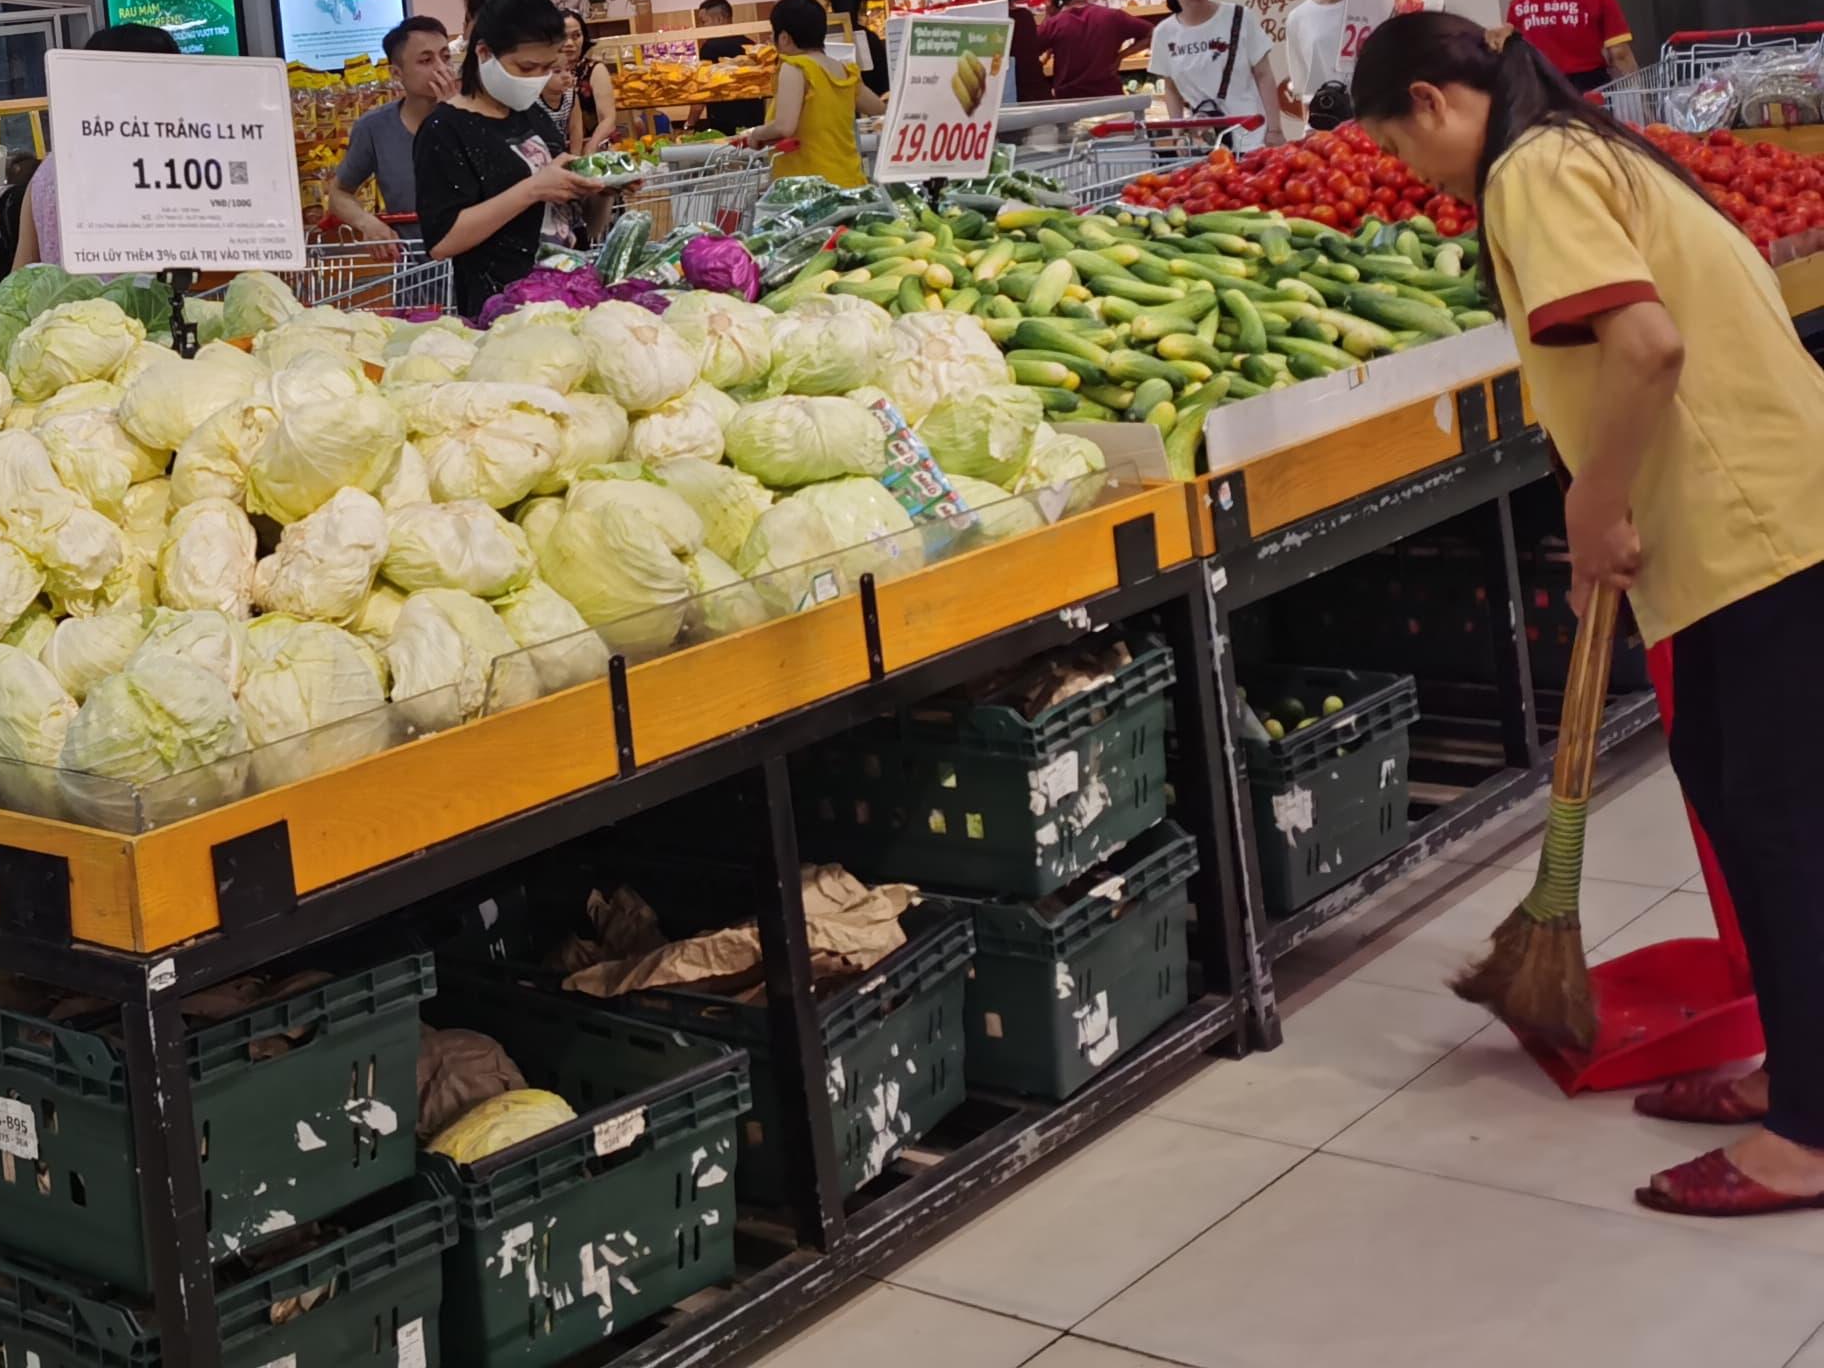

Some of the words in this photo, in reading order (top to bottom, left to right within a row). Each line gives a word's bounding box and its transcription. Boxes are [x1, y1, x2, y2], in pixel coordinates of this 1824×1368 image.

[120, 115, 149, 137] CẢI
[217, 124, 235, 139] L1
[241, 124, 264, 140] MT
[890, 120, 992, 163] 19.000đ
[133, 157, 222, 189] 1.100
[75, 248, 100, 262] TÍCH
[126, 248, 154, 261] THÊM
[157, 249, 176, 261] 3%
[201, 250, 217, 262] TRỊ
[263, 249, 293, 261] VINID
